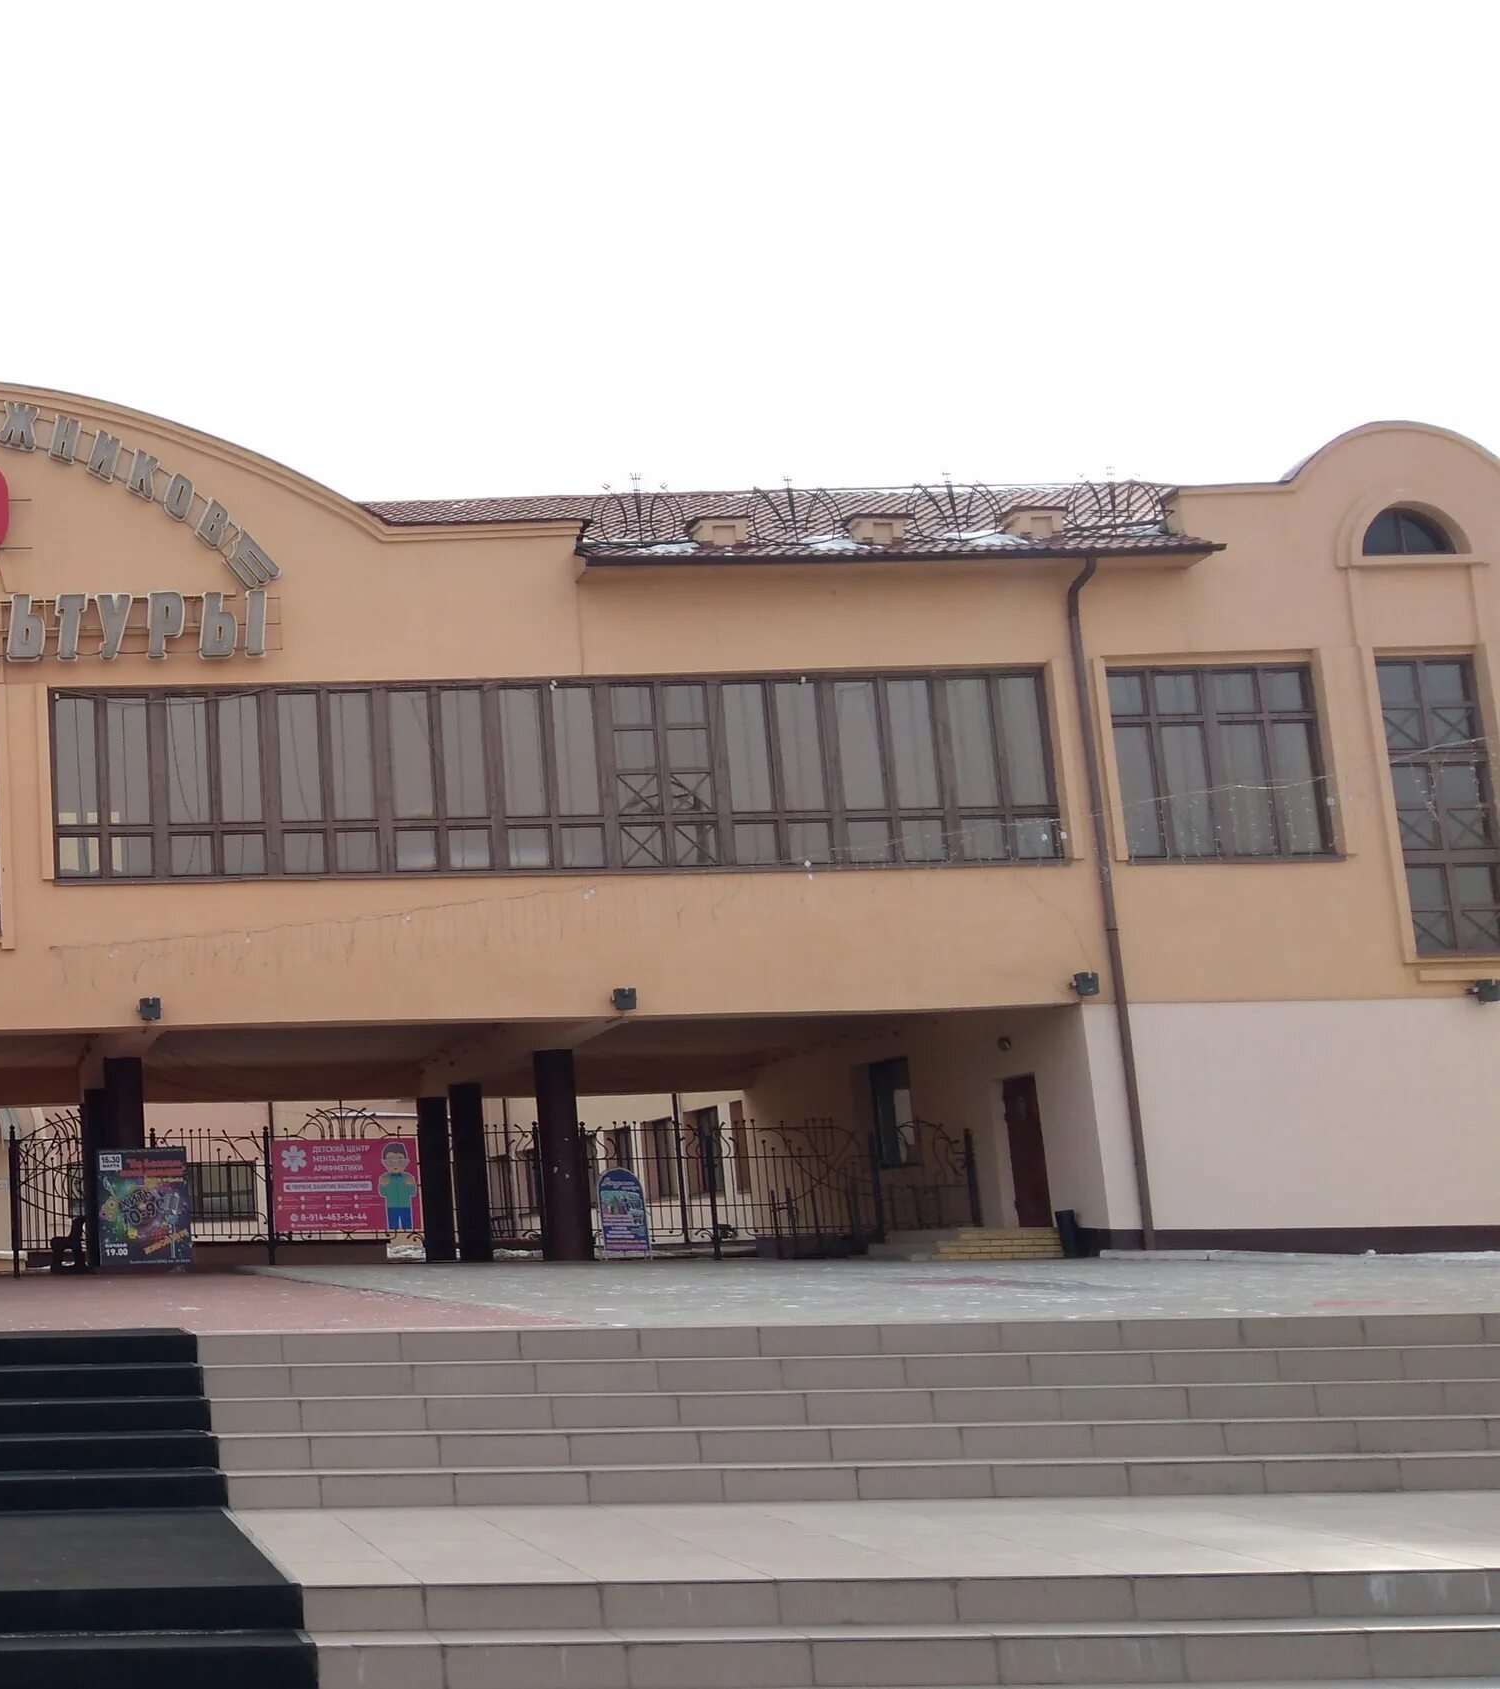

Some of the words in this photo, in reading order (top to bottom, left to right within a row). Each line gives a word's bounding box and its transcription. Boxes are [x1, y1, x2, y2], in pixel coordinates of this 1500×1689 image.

[312, 1144, 345, 1153] ДЕТСКИЙ
[346, 1145, 370, 1153] ЦЕНТР
[312, 1153, 361, 1161] МЕНТАЛЬНОЙ
[313, 1164, 363, 1172] АРИФМЕТИКИ
